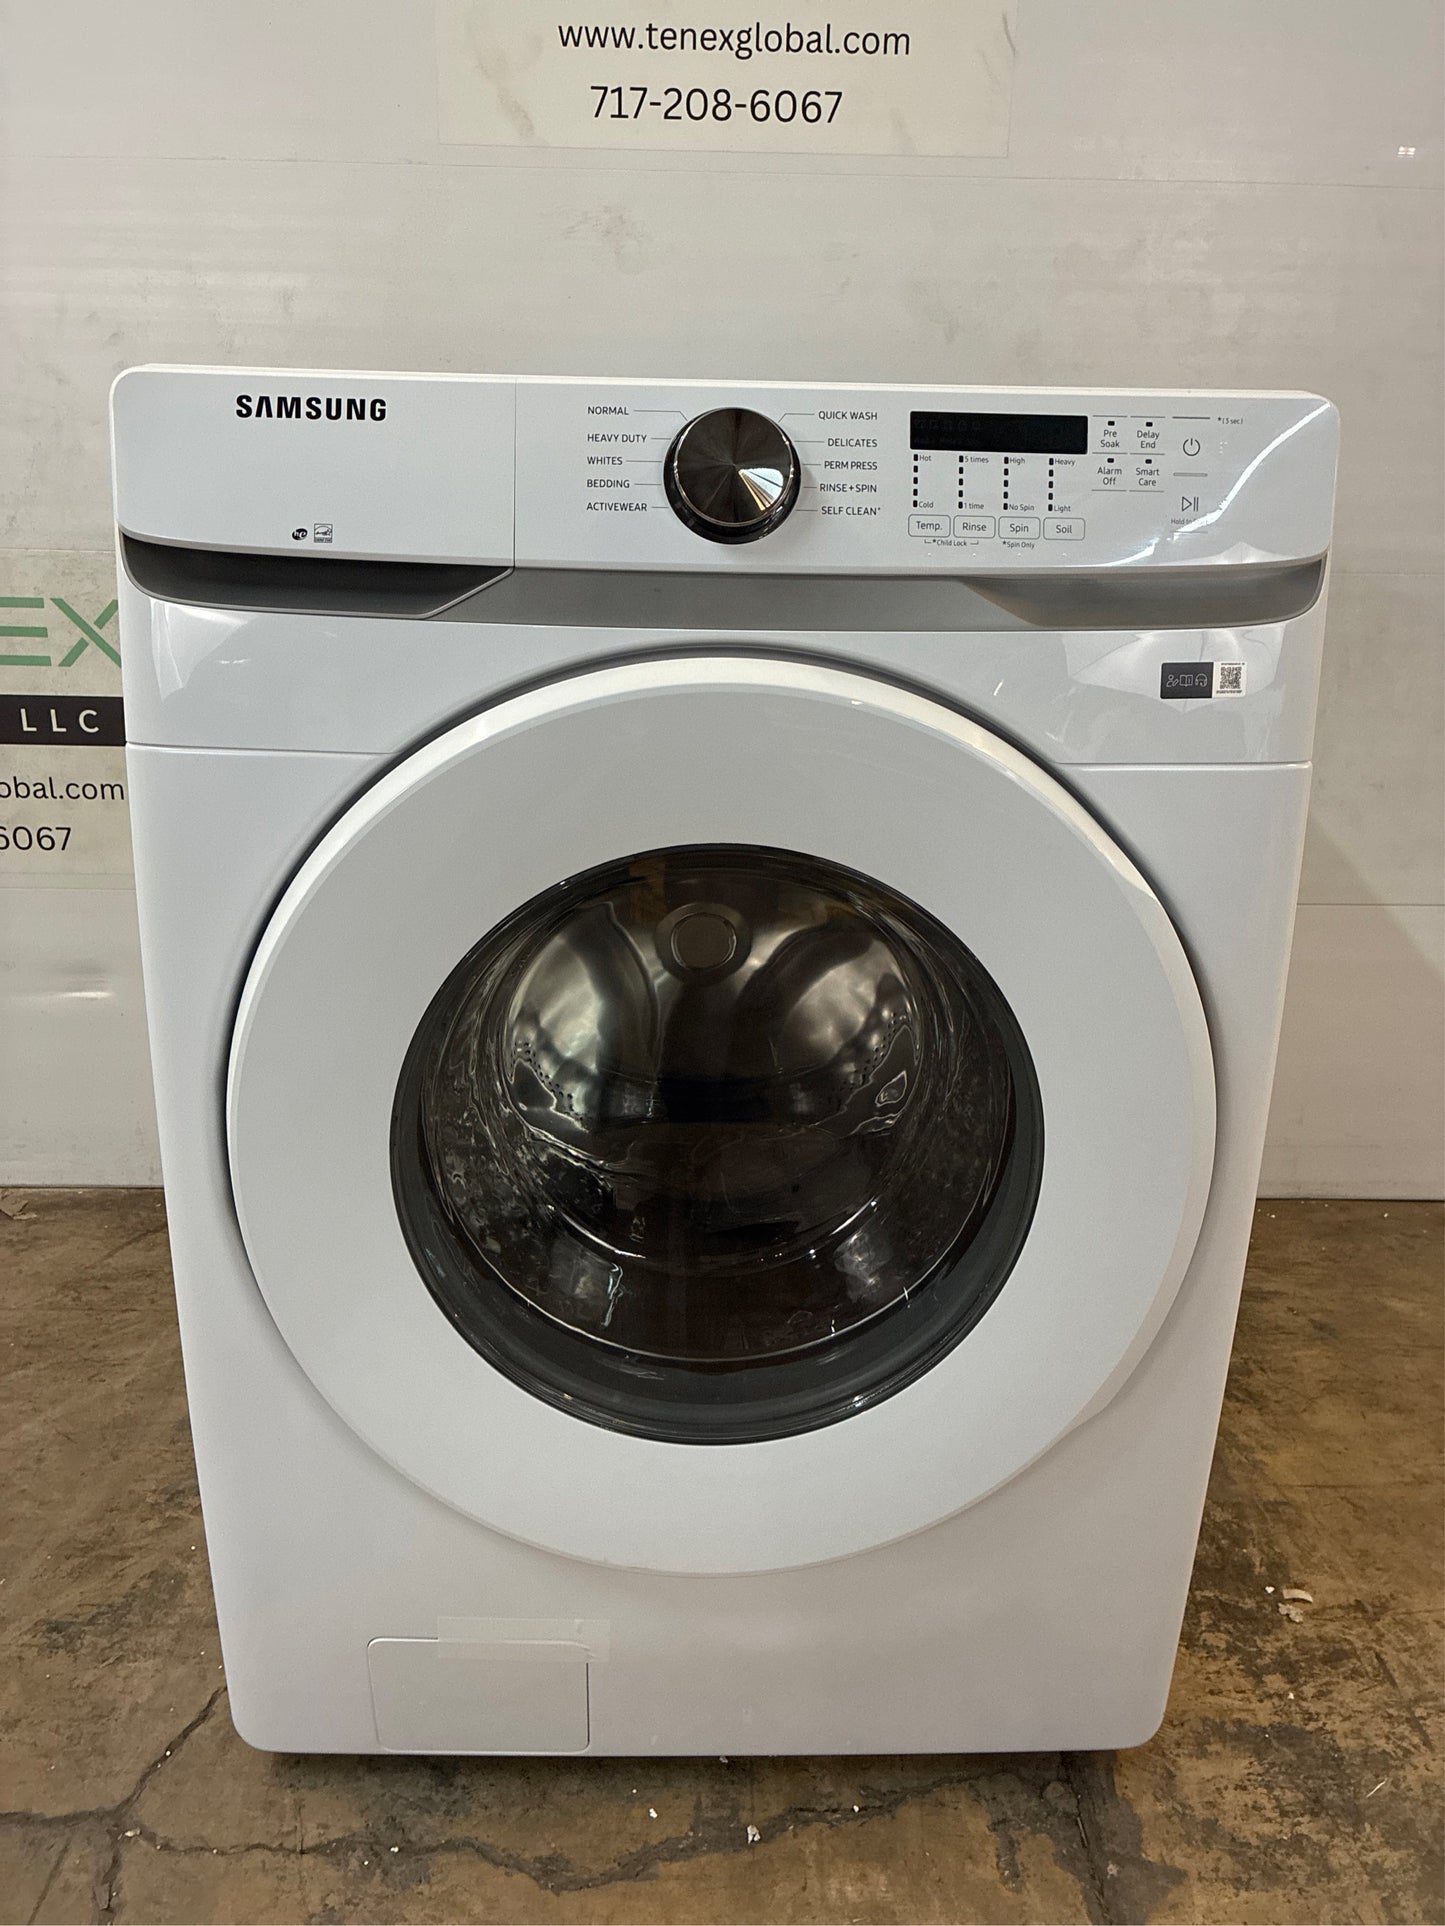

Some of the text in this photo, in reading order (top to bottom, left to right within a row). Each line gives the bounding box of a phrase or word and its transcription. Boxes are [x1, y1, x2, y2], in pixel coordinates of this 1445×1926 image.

[557, 21, 910, 61] www.tenexglobal.com
[590, 85, 843, 124] 717-208-6067
[235, 394, 387, 422] SAMSUNG
[587, 405, 630, 416] NORMAL
[818, 410, 878, 421] QUICK WASH
[587, 433, 648, 443] HEAVY DUTY
[1103, 429, 1118, 438] Pre
[1136, 430, 1161, 440] Delay
[827, 437, 878, 448] DELICATES
[1100, 439, 1120, 448] Soak
[1140, 440, 1156, 449] End
[586, 455, 623, 466] WHITES
[919, 454, 932, 462] Hot
[964, 455, 990, 464] 5 times
[1009, 457, 1026, 466] High
[1054, 458, 1076, 467] Heavy
[824, 460, 878, 471] PERM PRESS
[1096, 466, 1123, 475] Alarm
[1135, 467, 1160, 477] Smart
[586, 478, 630, 489] BEDDING
[1102, 476, 1117, 486] Off
[1138, 477, 1157, 487] Care
[586, 501, 648, 512] ACTIVEWEAR
[918, 500, 934, 509] Cold
[968, 502, 985, 510] time
[1008, 503, 1035, 513] No Spin
[1053, 505, 1072, 514] Light
[821, 505, 844, 516] SELF
[916, 520, 943, 533] Temp.
[962, 521, 987, 532] Rinse
[1009, 522, 1029, 535] Spin
[1055, 524, 1073, 534] Soil
[953, 539, 968, 547] Lock
[1020, 541, 1036, 550] Only
[20, 707, 100, 733] LLC
